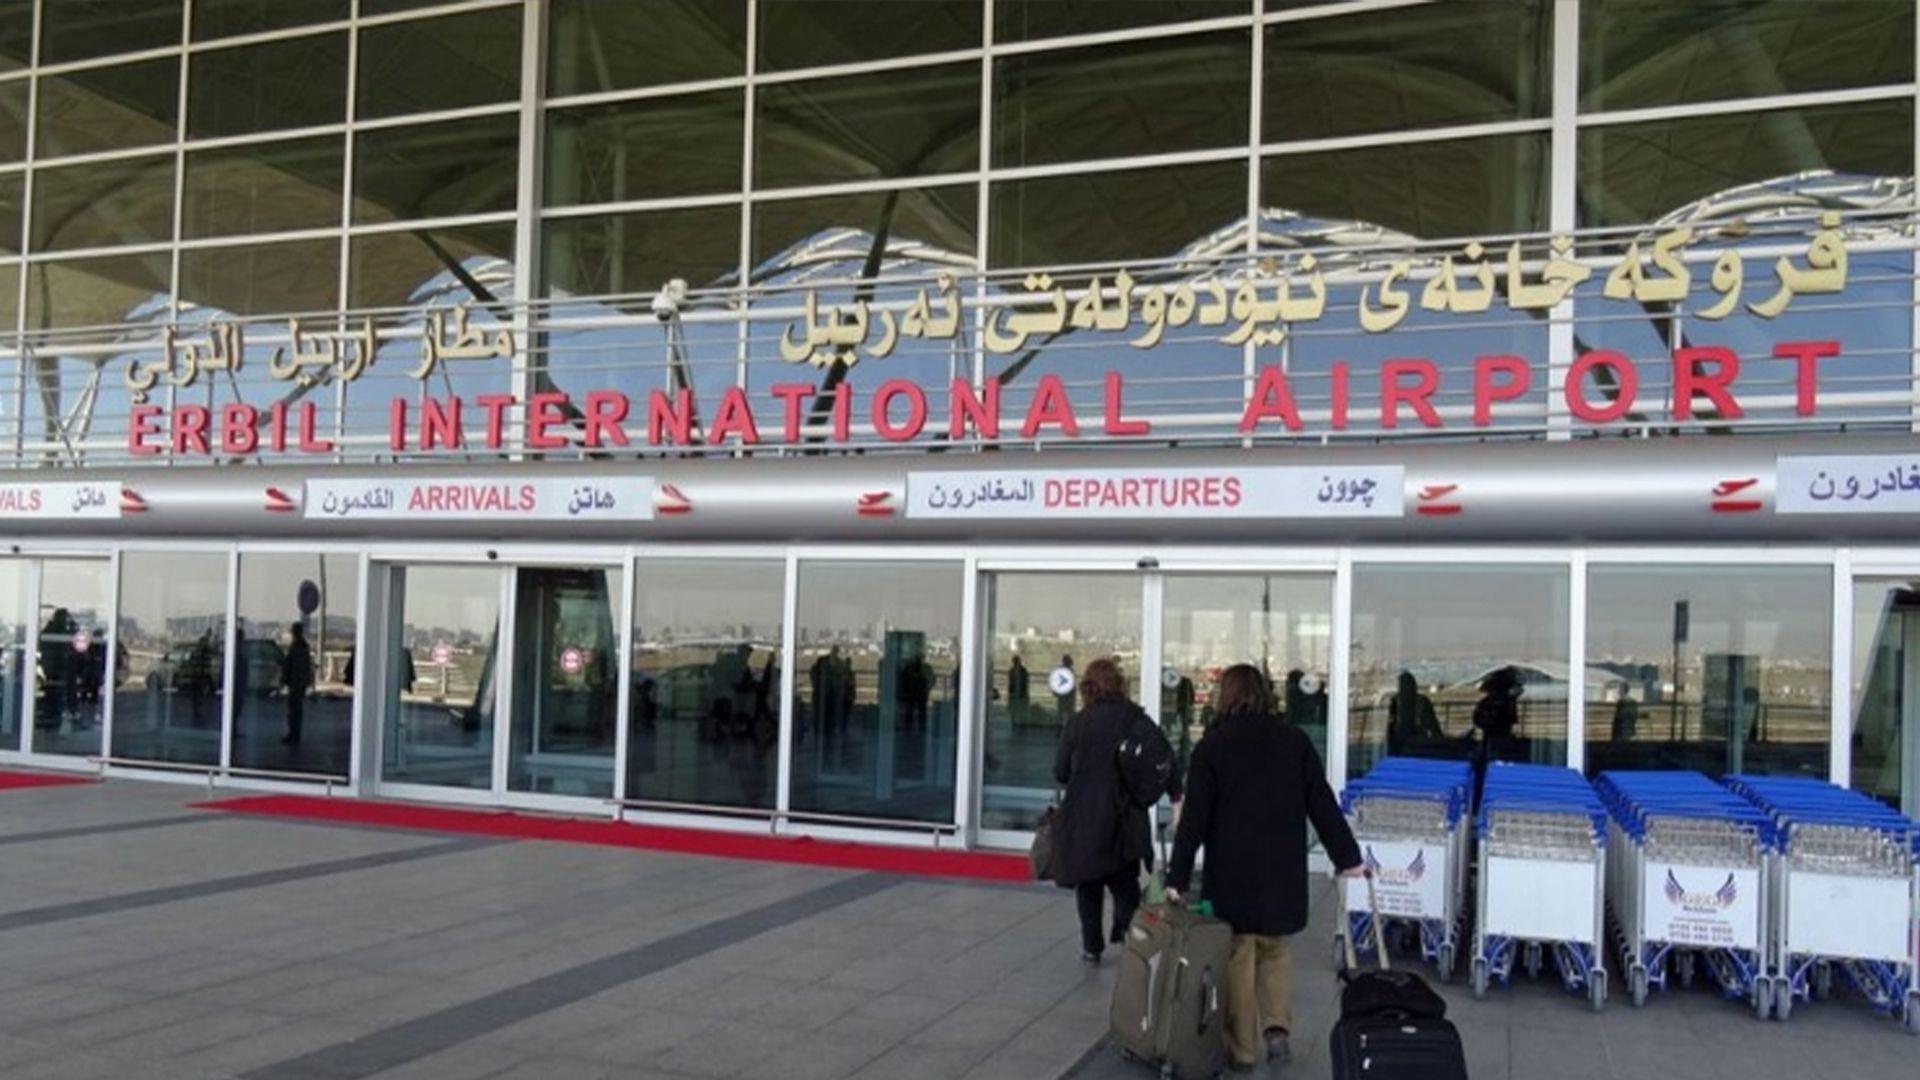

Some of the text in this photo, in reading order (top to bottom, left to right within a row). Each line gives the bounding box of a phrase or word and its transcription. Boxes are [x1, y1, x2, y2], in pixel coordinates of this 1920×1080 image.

[125, 322, 244, 405] الدولي
[406, 304, 514, 380] مطار
[128, 340, 1842, 455] ERBIL INTERNATIONAL AIRPORT
[408, 485, 536, 511] ARRIVALS
[927, 479, 1034, 509] المغادرون
[1043, 476, 1242, 508] DEPARTURES
